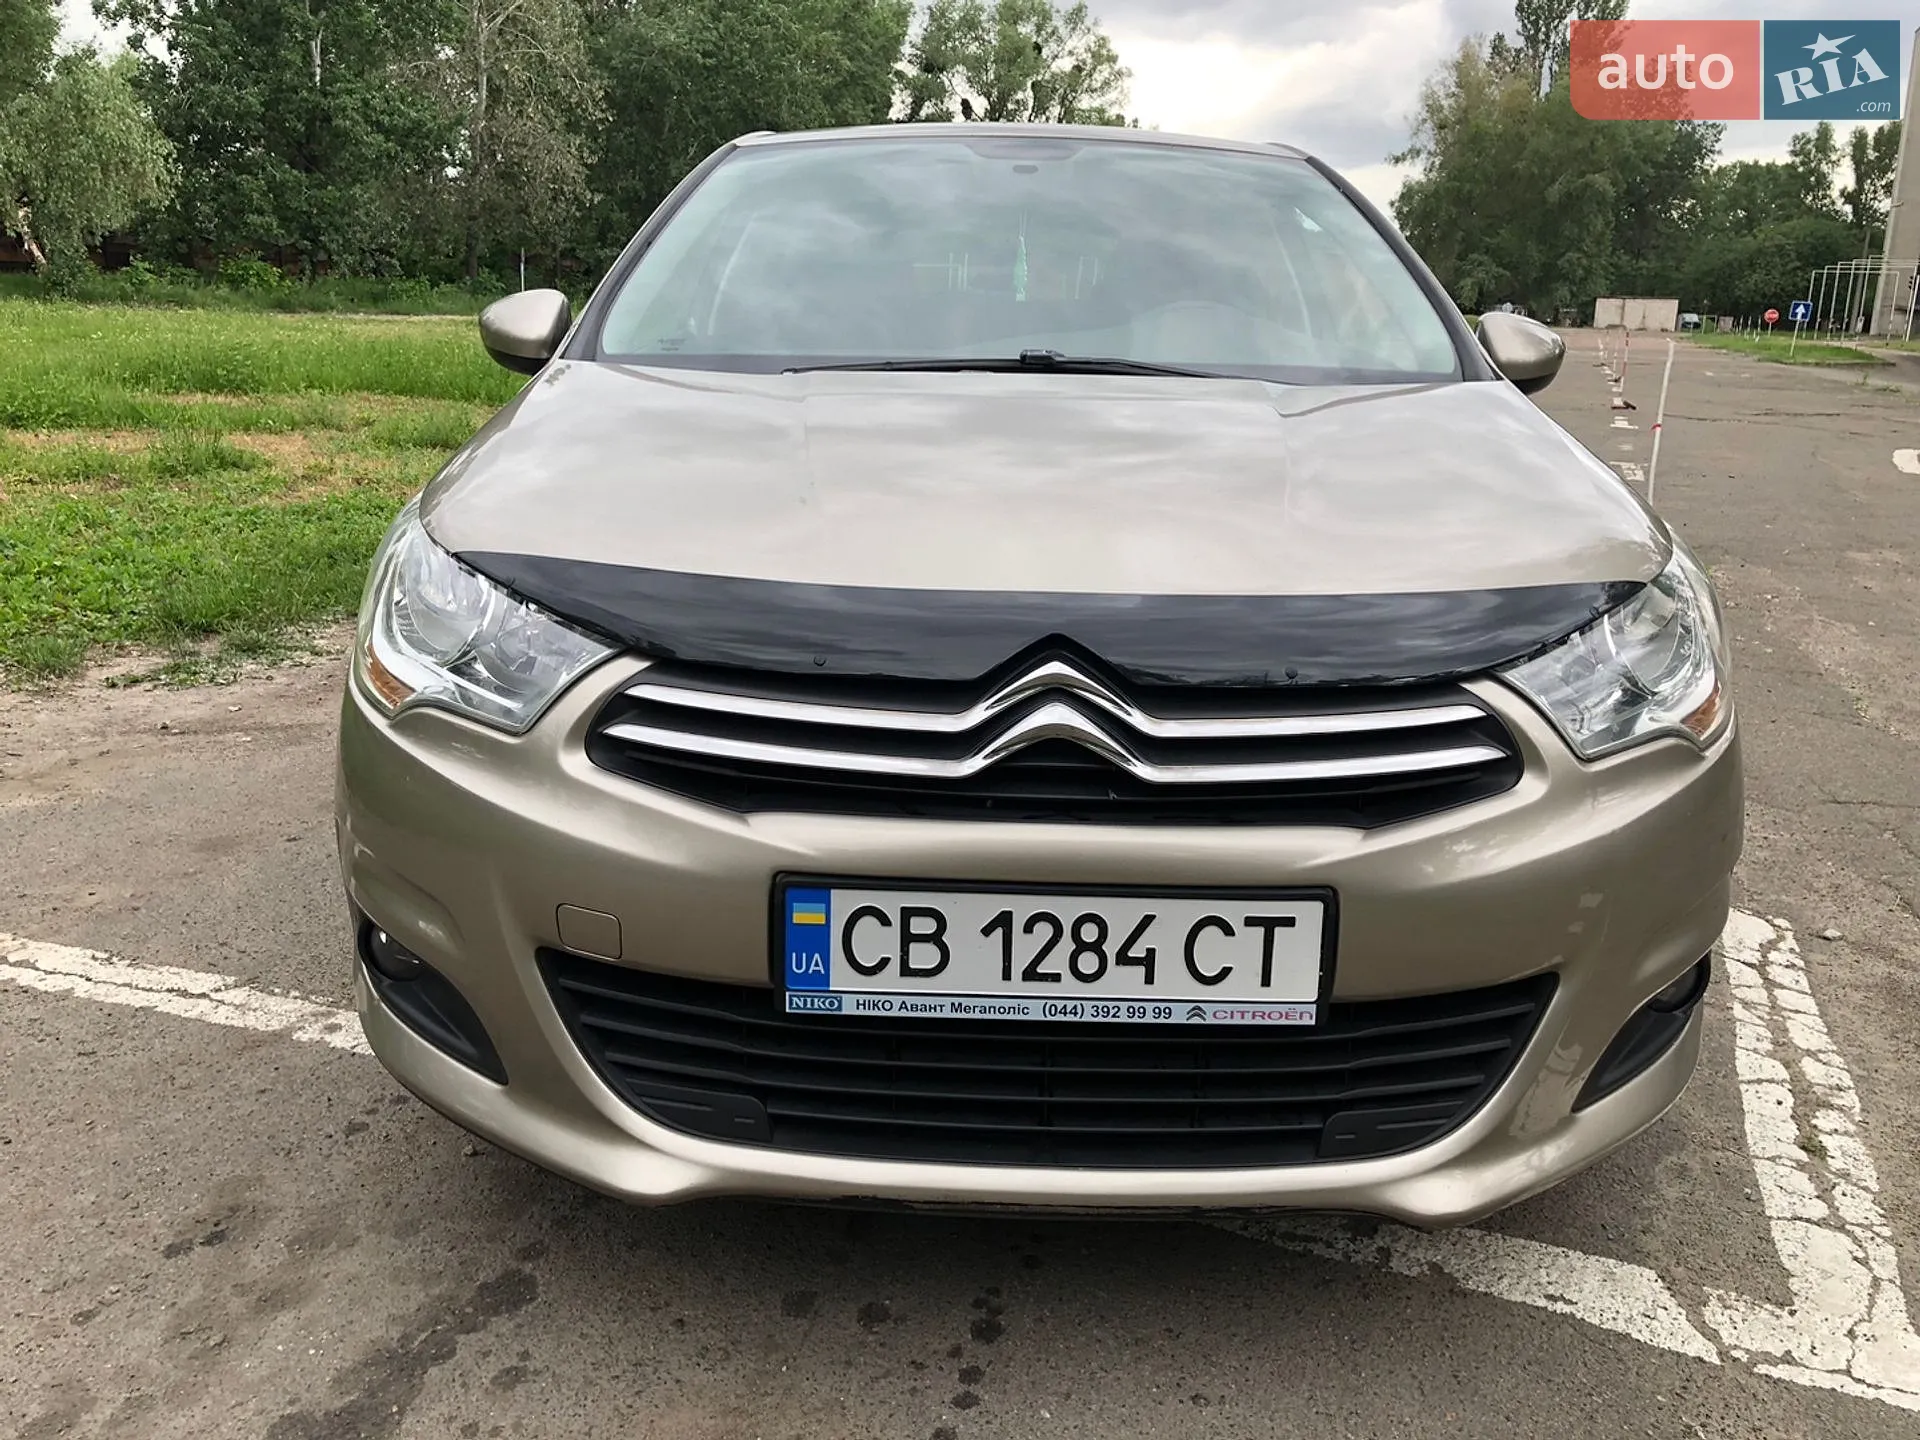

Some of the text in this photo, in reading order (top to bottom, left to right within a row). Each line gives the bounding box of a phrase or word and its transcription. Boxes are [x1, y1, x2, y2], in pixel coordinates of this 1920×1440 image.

[841, 903, 1296, 988] CB 1284 CT
[791, 953, 825, 975] UA
[791, 996, 841, 1010] NIKO
[898, 1000, 946, 1014] Авант
[950, 1001, 1031, 1016] Мегаполіс
[1042, 1002, 1085, 1019] (044)
[1090, 1004, 1121, 1019] 392
[1126, 1005, 1147, 1019] 99
[1152, 1006, 1173, 1020] 99
